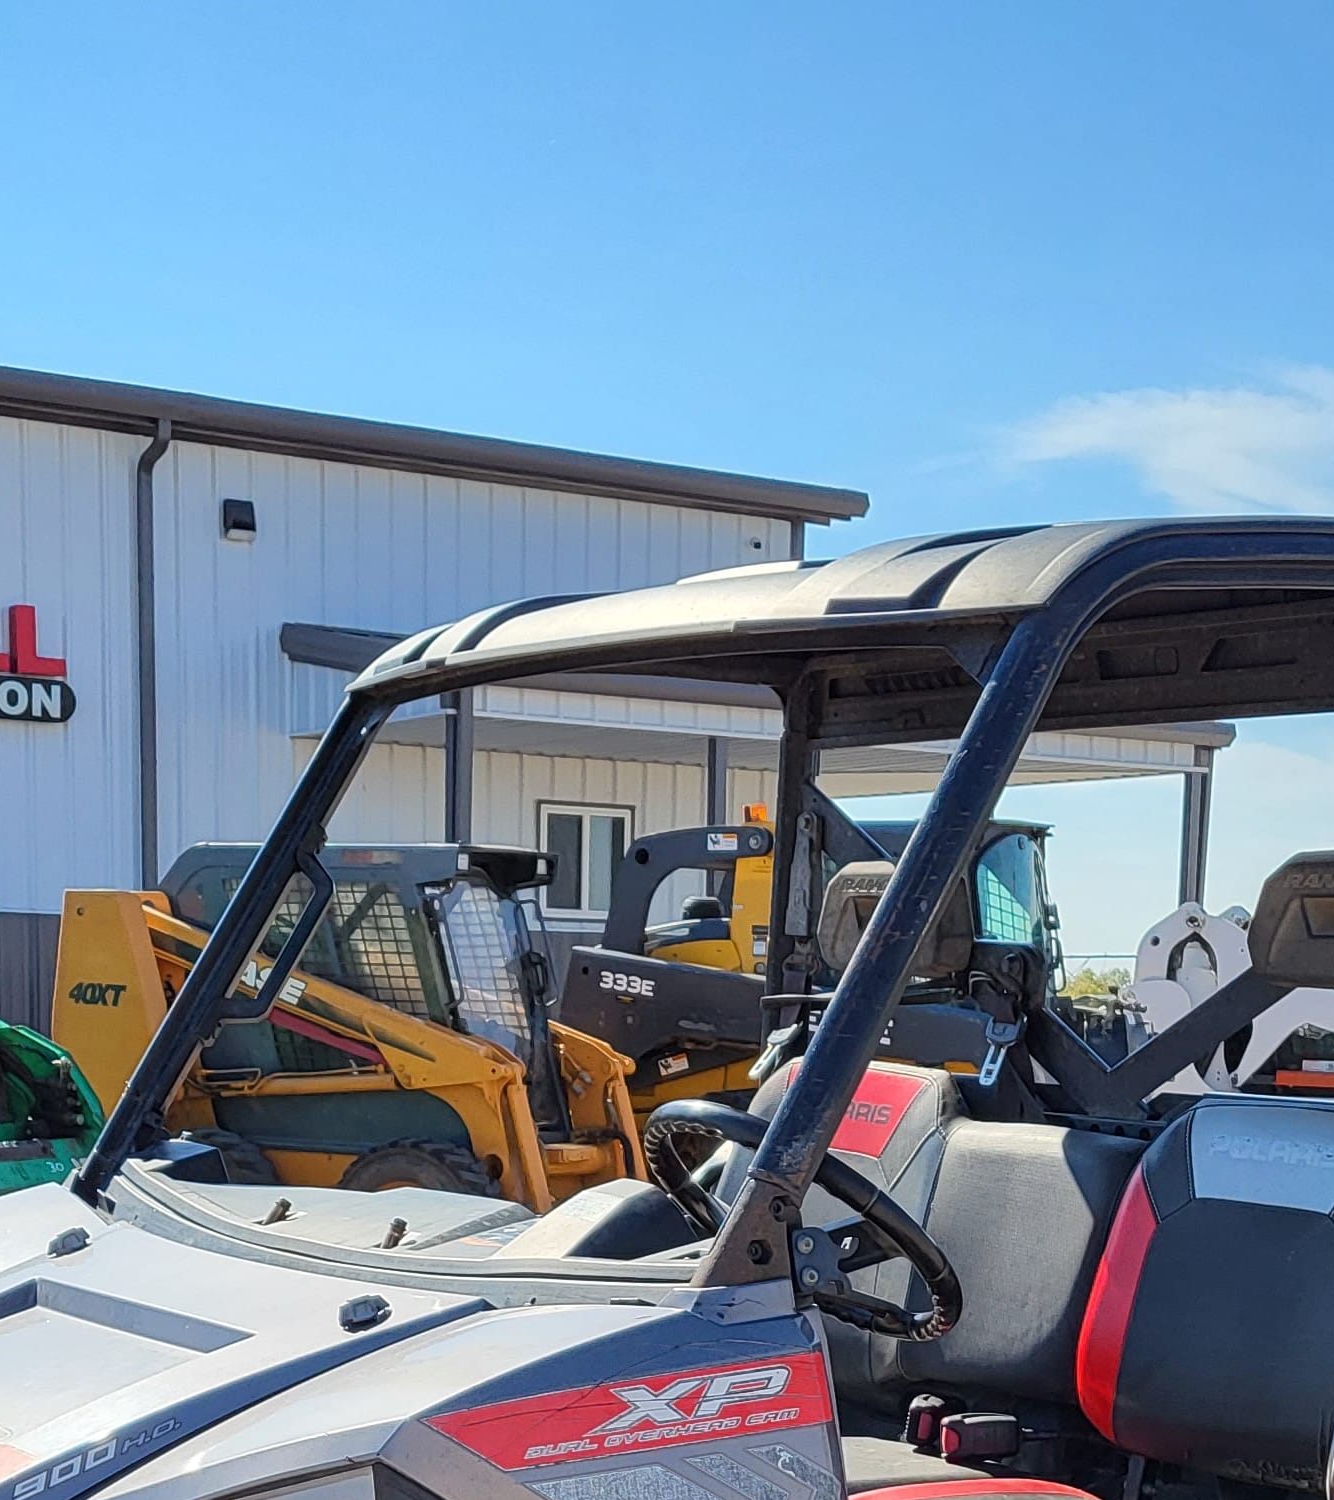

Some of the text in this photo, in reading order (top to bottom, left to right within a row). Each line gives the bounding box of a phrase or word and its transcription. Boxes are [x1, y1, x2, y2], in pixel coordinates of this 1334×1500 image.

[69, 982, 127, 1007] 40XT
[599, 971, 655, 996] 333E
[582, 1364, 791, 1437] XP
[121, 1418, 182, 1455] H.O.
[524, 1408, 800, 1460] DUAL OVERHEAD CAM
